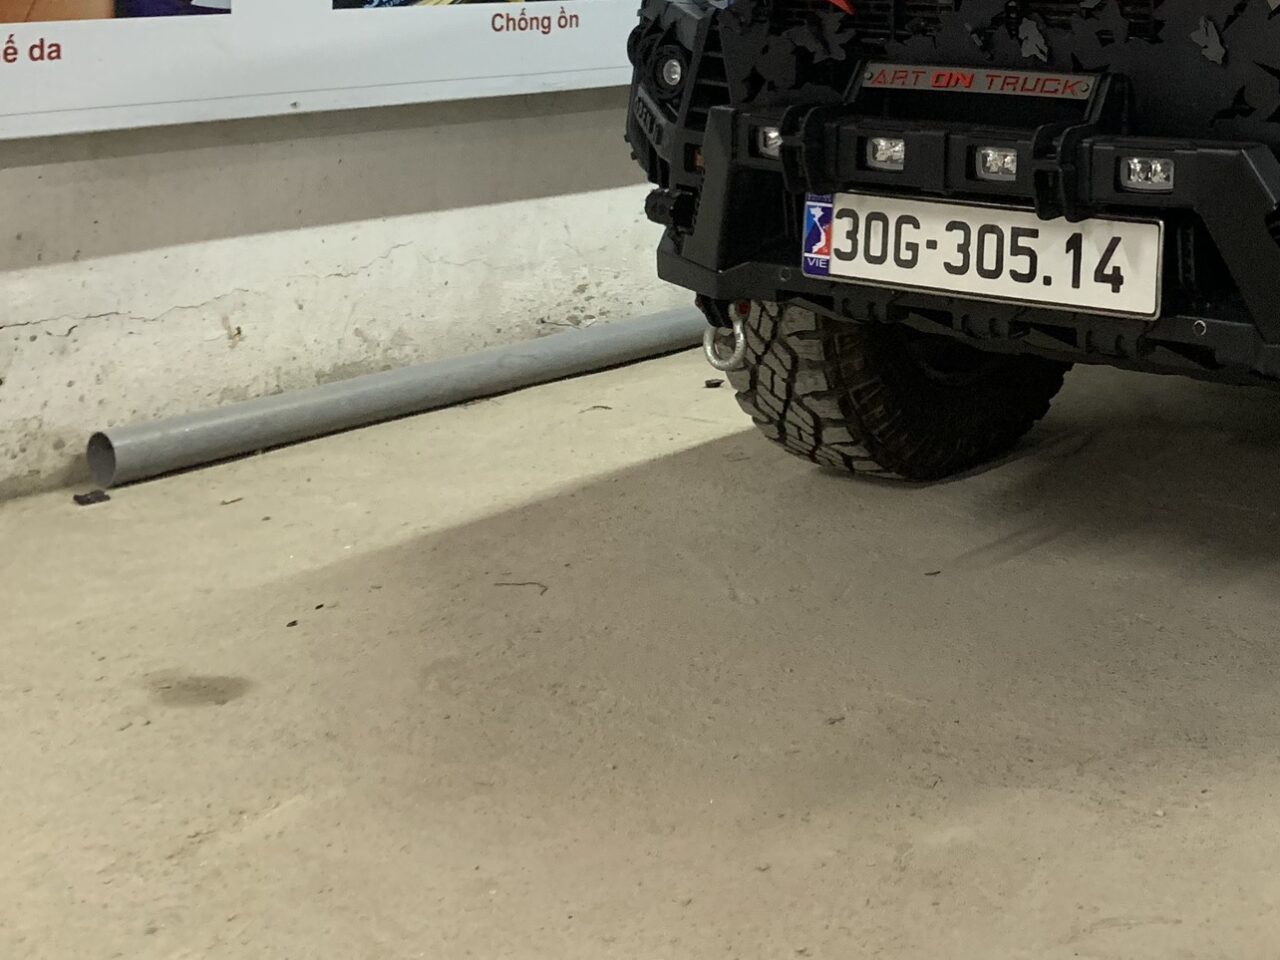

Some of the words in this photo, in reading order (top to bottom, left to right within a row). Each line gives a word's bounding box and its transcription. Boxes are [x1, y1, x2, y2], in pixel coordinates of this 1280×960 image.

[491, 7, 552, 35] Chống
[28, 37, 62, 62] da
[871, 67, 928, 86] ART
[930, 70, 974, 89] ON
[985, 73, 1086, 97] TRUCK
[807, 256, 827, 269] VIE
[832, 207, 1125, 294] 30G-305.14
